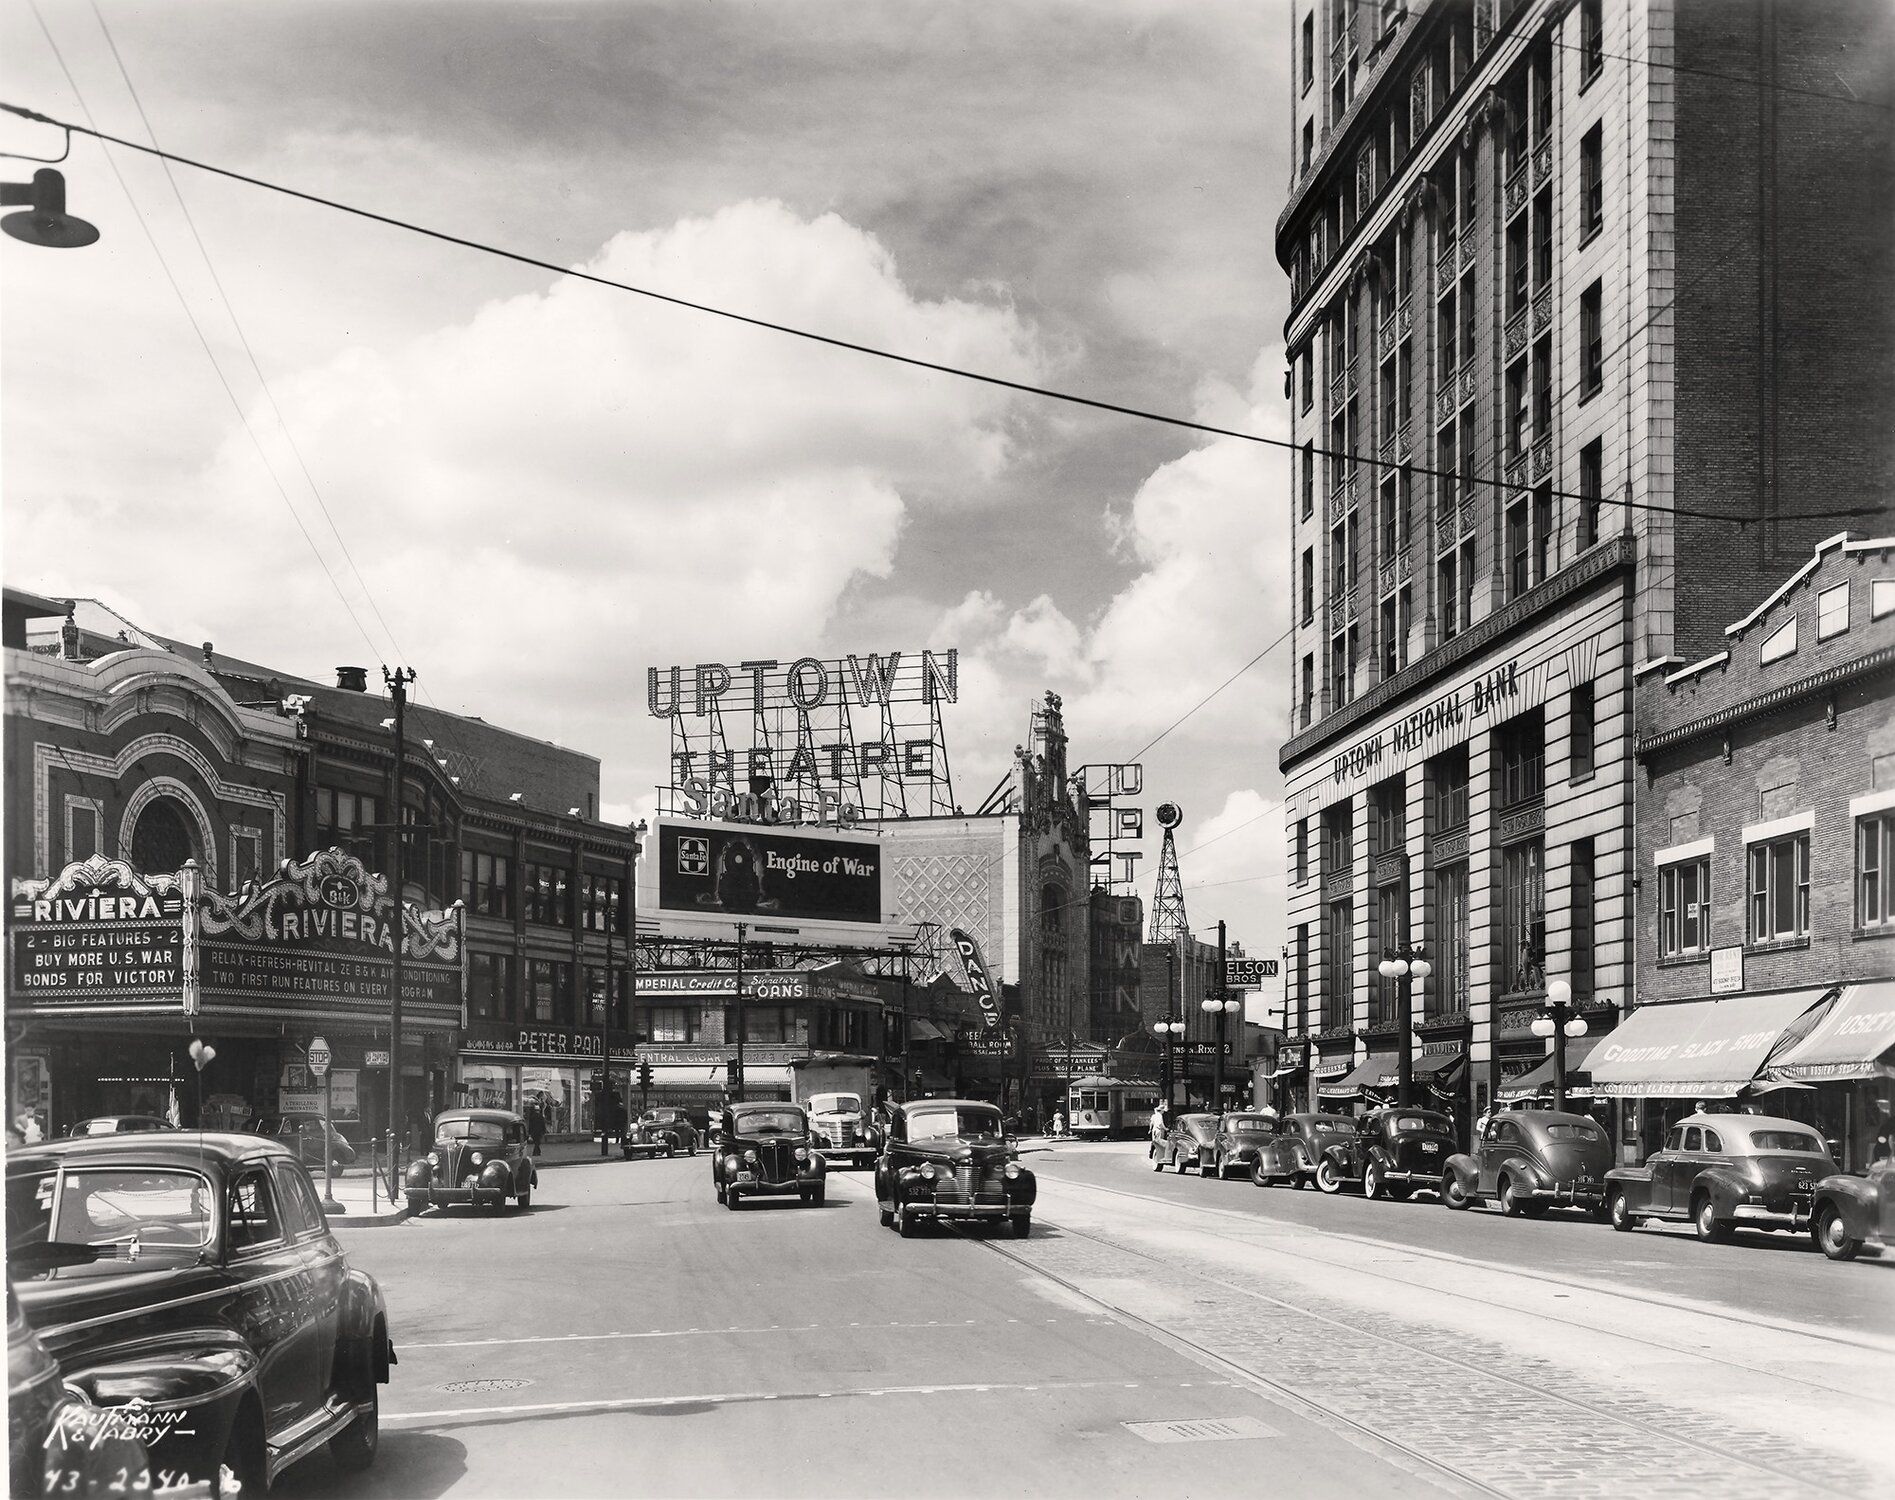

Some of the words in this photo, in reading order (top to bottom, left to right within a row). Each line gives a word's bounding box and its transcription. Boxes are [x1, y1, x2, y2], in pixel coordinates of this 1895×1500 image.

[648, 649, 957, 719] UPTOWN
[1335, 735, 1383, 785] UPTOWN
[1393, 693, 1463, 756] NATIONAL
[1474, 661, 1519, 714] BANK
[671, 739, 934, 787] THEATRE
[683, 777, 802, 826] Santa
[814, 790, 860, 831] Fe
[766, 851, 819, 879] Engine
[823, 856, 841, 873] of
[842, 857, 875, 877] War
[1116, 764, 1143, 1013] UPTOWN
[35, 897, 161, 922] RIVIERA
[27, 935, 35, 948] 2
[53, 935, 76, 948] BIG
[82, 931, 151, 946] FEATURES
[170, 930, 179, 943] 2
[283, 909, 394, 952] RIVIERA
[35, 953, 62, 967] BUY
[68, 952, 103, 967] MORE
[142, 950, 173, 964] WAR
[24, 973, 67, 986] BONDS
[78, 972, 103, 987] FOR
[114, 970, 175, 984] VICTORY
[213, 970, 235, 984] TWO
[241, 973, 268, 986] FIRST
[272, 975, 290, 987] RUN
[294, 977, 340, 992] FEATURES
[344, 981, 356, 993] ON
[360, 982, 387, 995] EVERY
[401, 986, 433, 999] ROGRAM
[402, 969, 451, 983] ONDITIONING
[635, 978, 686, 990] MPERIAL
[689, 978, 721, 990] Credit
[957, 941, 999, 1027] DANCE
[1226, 975, 1259, 983] BROS.
[518, 1031, 567, 1053] PETER
[573, 1034, 601, 1055] PAN
[1604, 1044, 1675, 1063] GOODTIME
[1679, 1038, 1730, 1059] SLACK
[1730, 1030, 1776, 1052] SHOP
[310, 1051, 328, 1063] STOP
[687, 1053, 721, 1063] CIGAR
